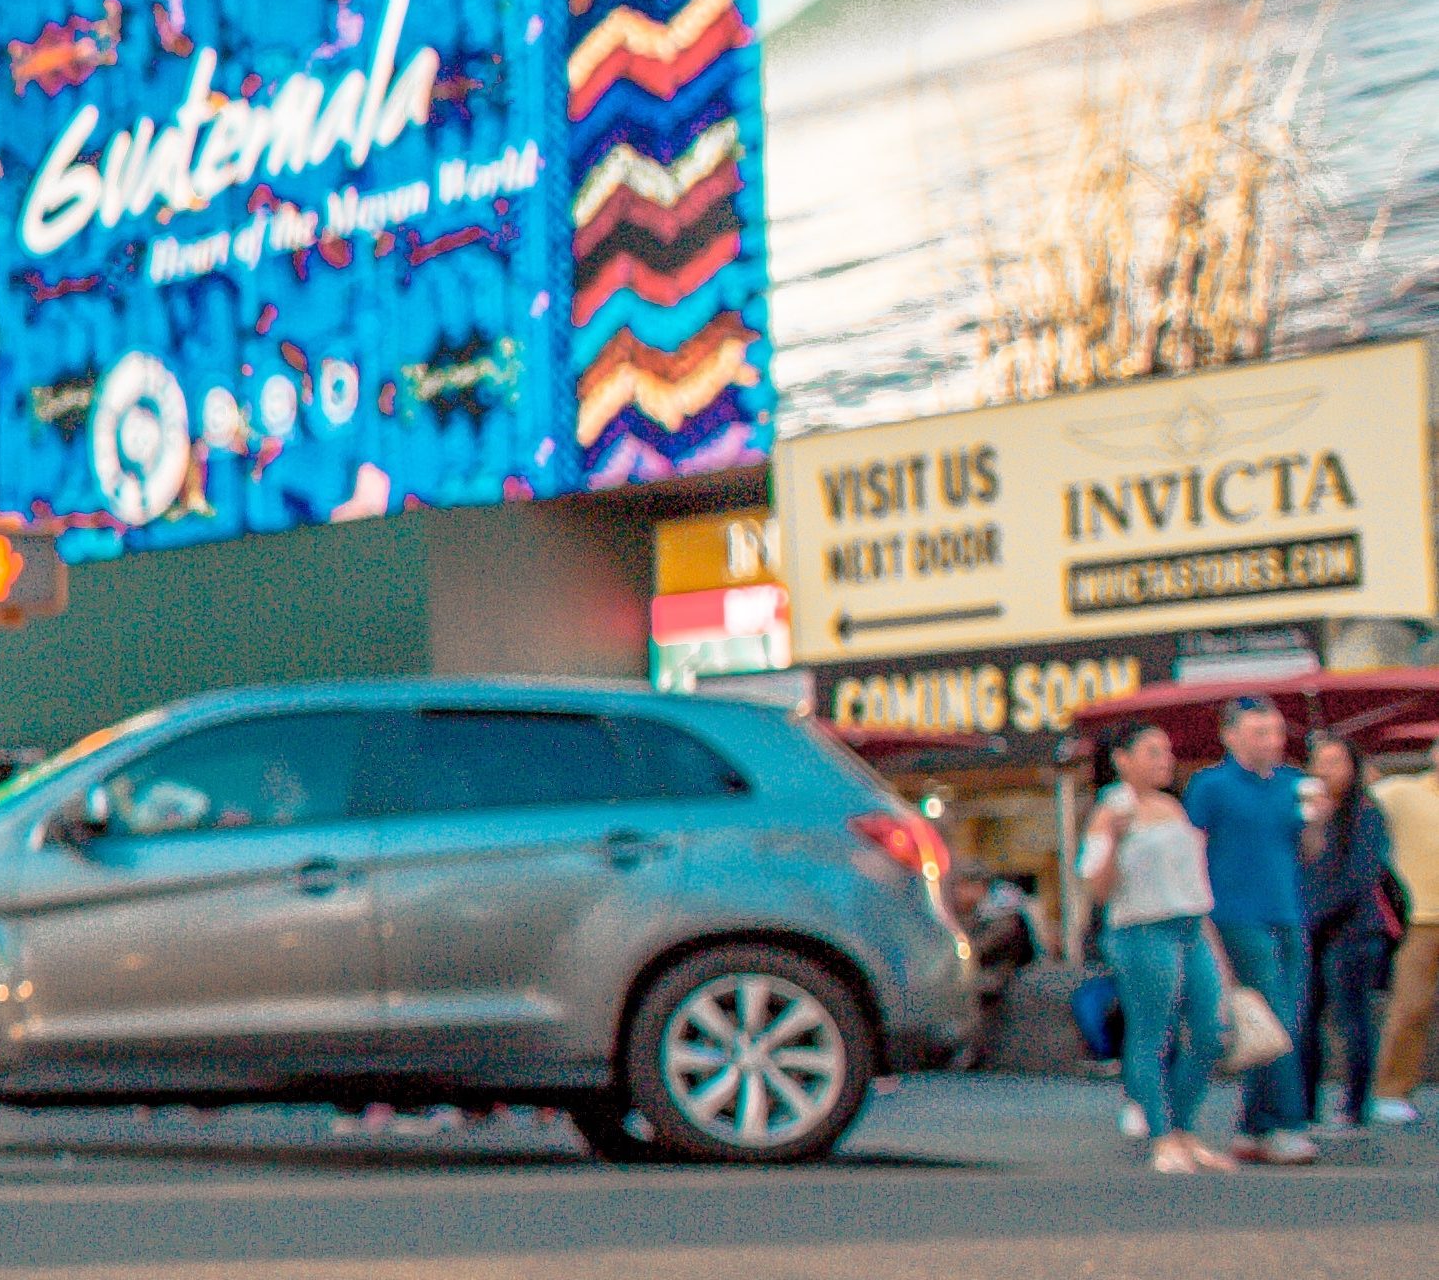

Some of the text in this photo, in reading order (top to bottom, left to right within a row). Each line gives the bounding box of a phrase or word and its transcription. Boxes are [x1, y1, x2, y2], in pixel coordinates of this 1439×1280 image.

[820, 443, 1001, 523] VISIT US
[1062, 447, 1358, 544] INVICTA
[824, 535, 906, 583] NEXT
[913, 524, 1003, 577] DOOR
[835, 656, 1143, 733] COMING SOON
